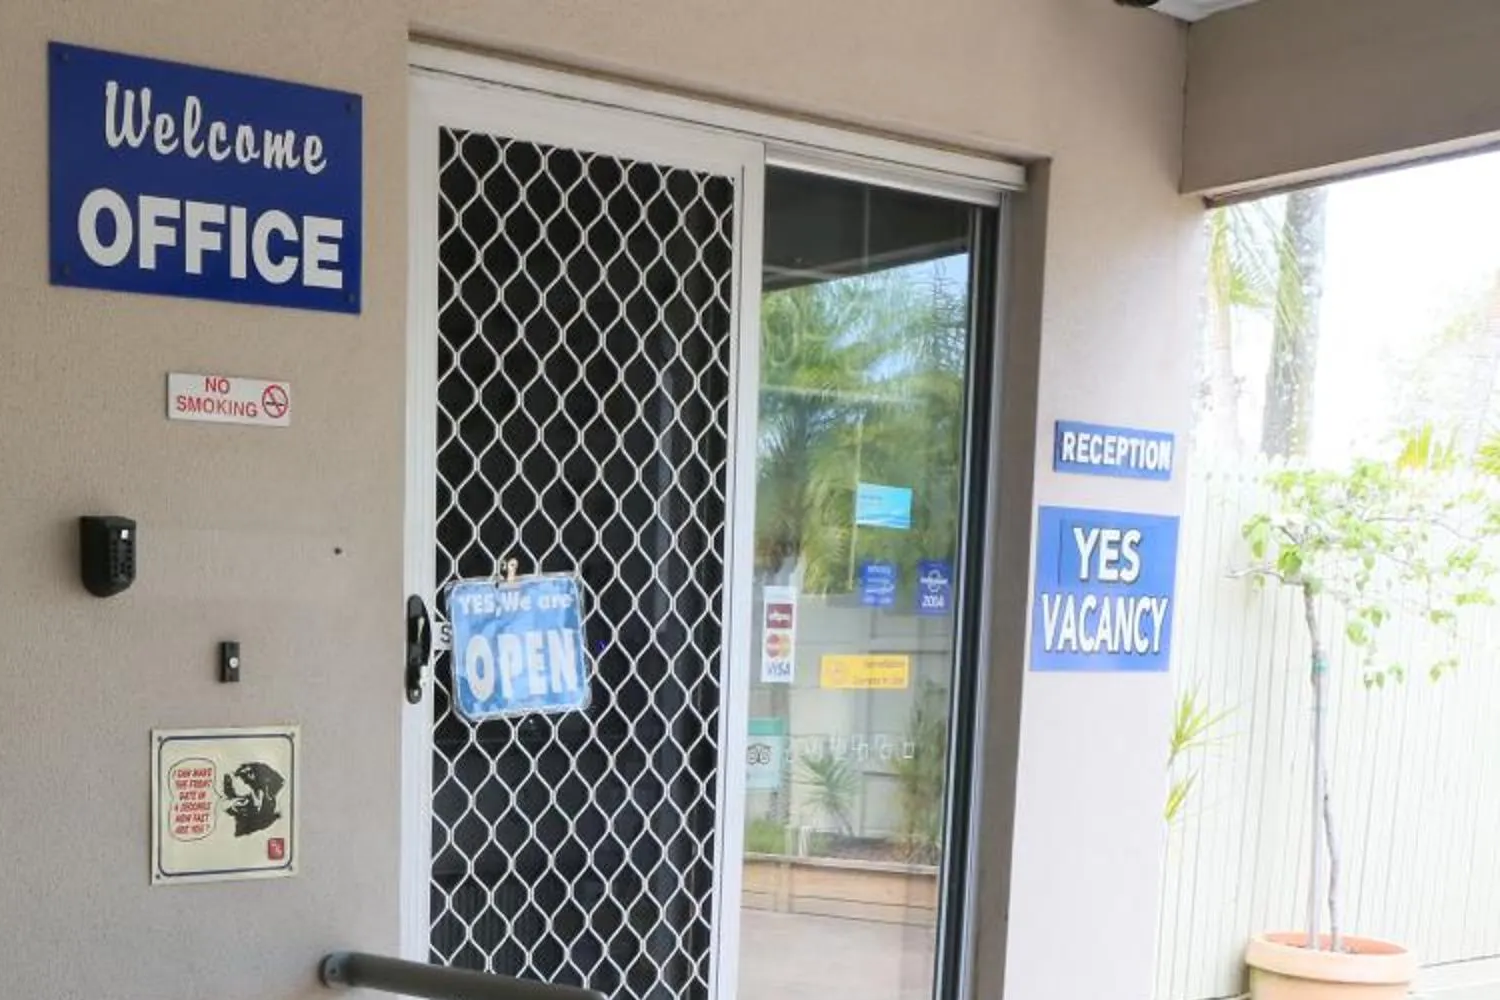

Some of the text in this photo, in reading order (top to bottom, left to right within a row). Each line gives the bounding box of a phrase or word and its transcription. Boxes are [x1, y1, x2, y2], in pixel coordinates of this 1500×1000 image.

[105, 80, 327, 175] Welcome
[77, 188, 343, 289] OFFICE
[175, 395, 258, 418] SMOKING
[204, 376, 231, 395] NO
[1061, 431, 1171, 471] RECEPTION
[1073, 527, 1142, 582] YES
[1041, 594, 1169, 654] VACANCY
[465, 628, 579, 702] OPEN
